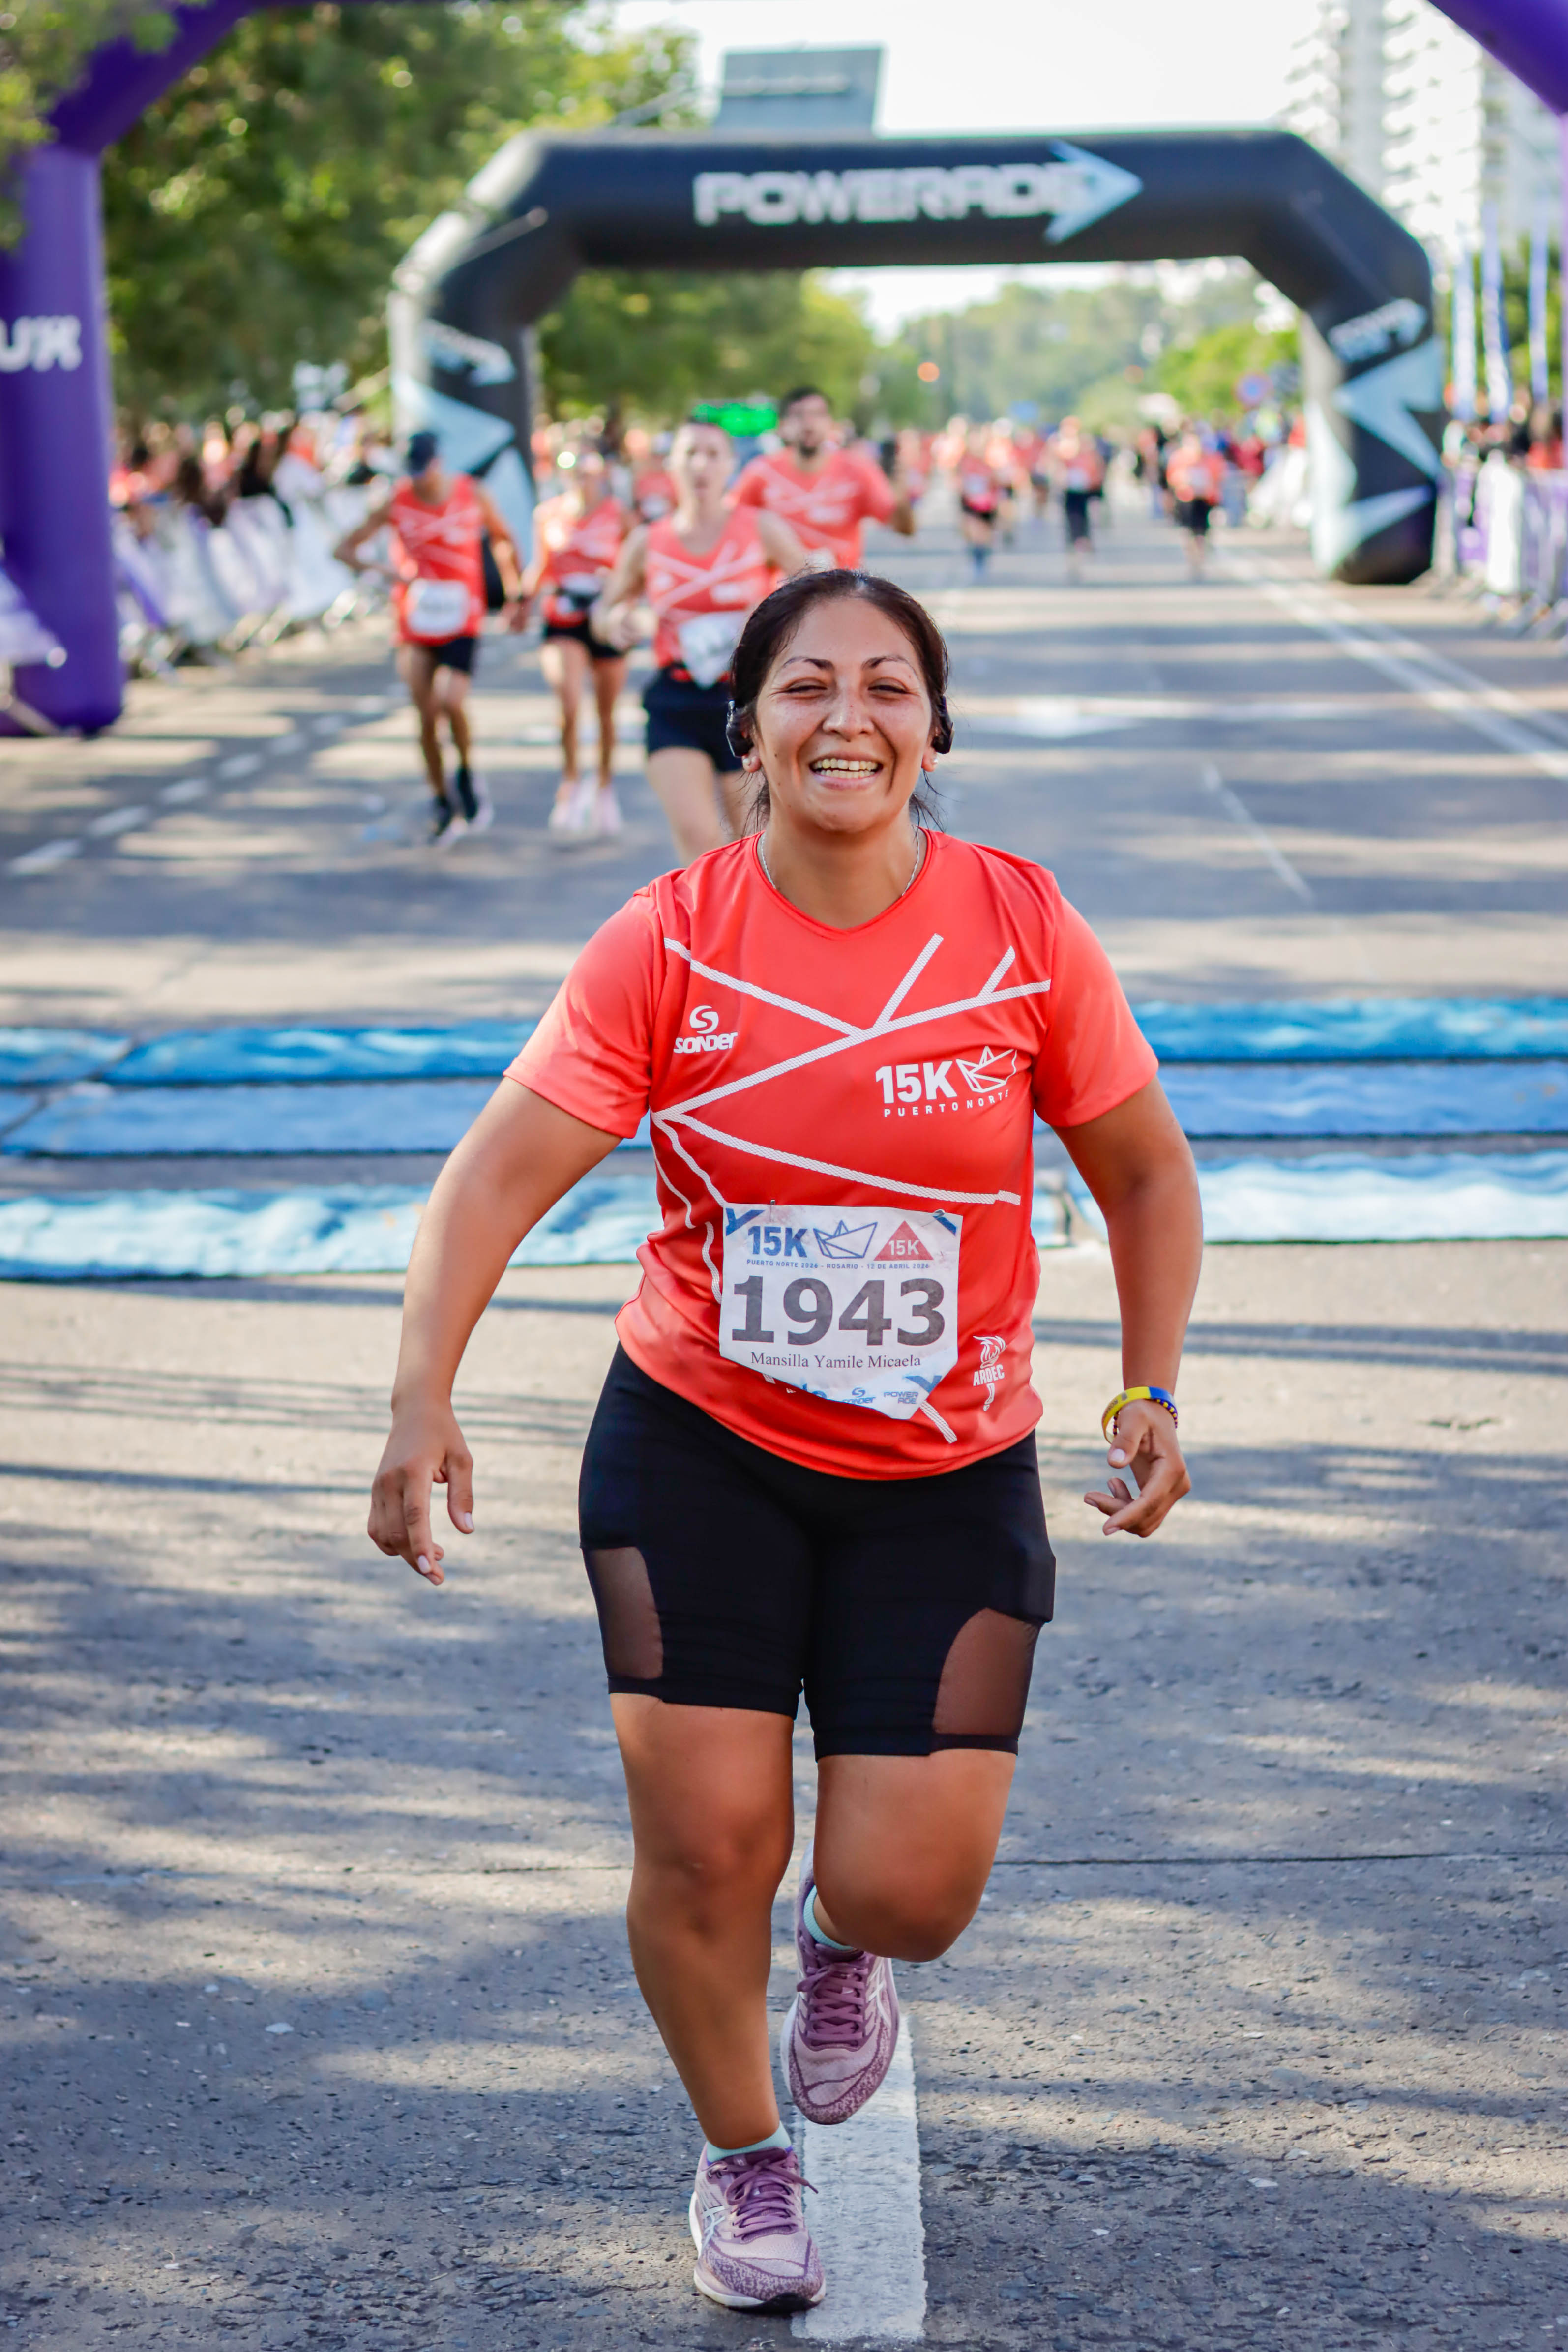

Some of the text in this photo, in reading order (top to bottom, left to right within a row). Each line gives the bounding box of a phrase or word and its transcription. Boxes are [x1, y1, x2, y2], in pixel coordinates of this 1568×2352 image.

[875, 1061, 958, 1104] 15K
[884, 1089, 1009, 1117] PUERTO NORTE
[747, 1225, 808, 1258] 15K
[888, 1239, 919, 1256] 15K
[732, 1275, 945, 1346] 1943
[751, 1352, 921, 1368] Mansilla Yamile Micaela
[973, 1364, 1005, 1386] ARDEC
